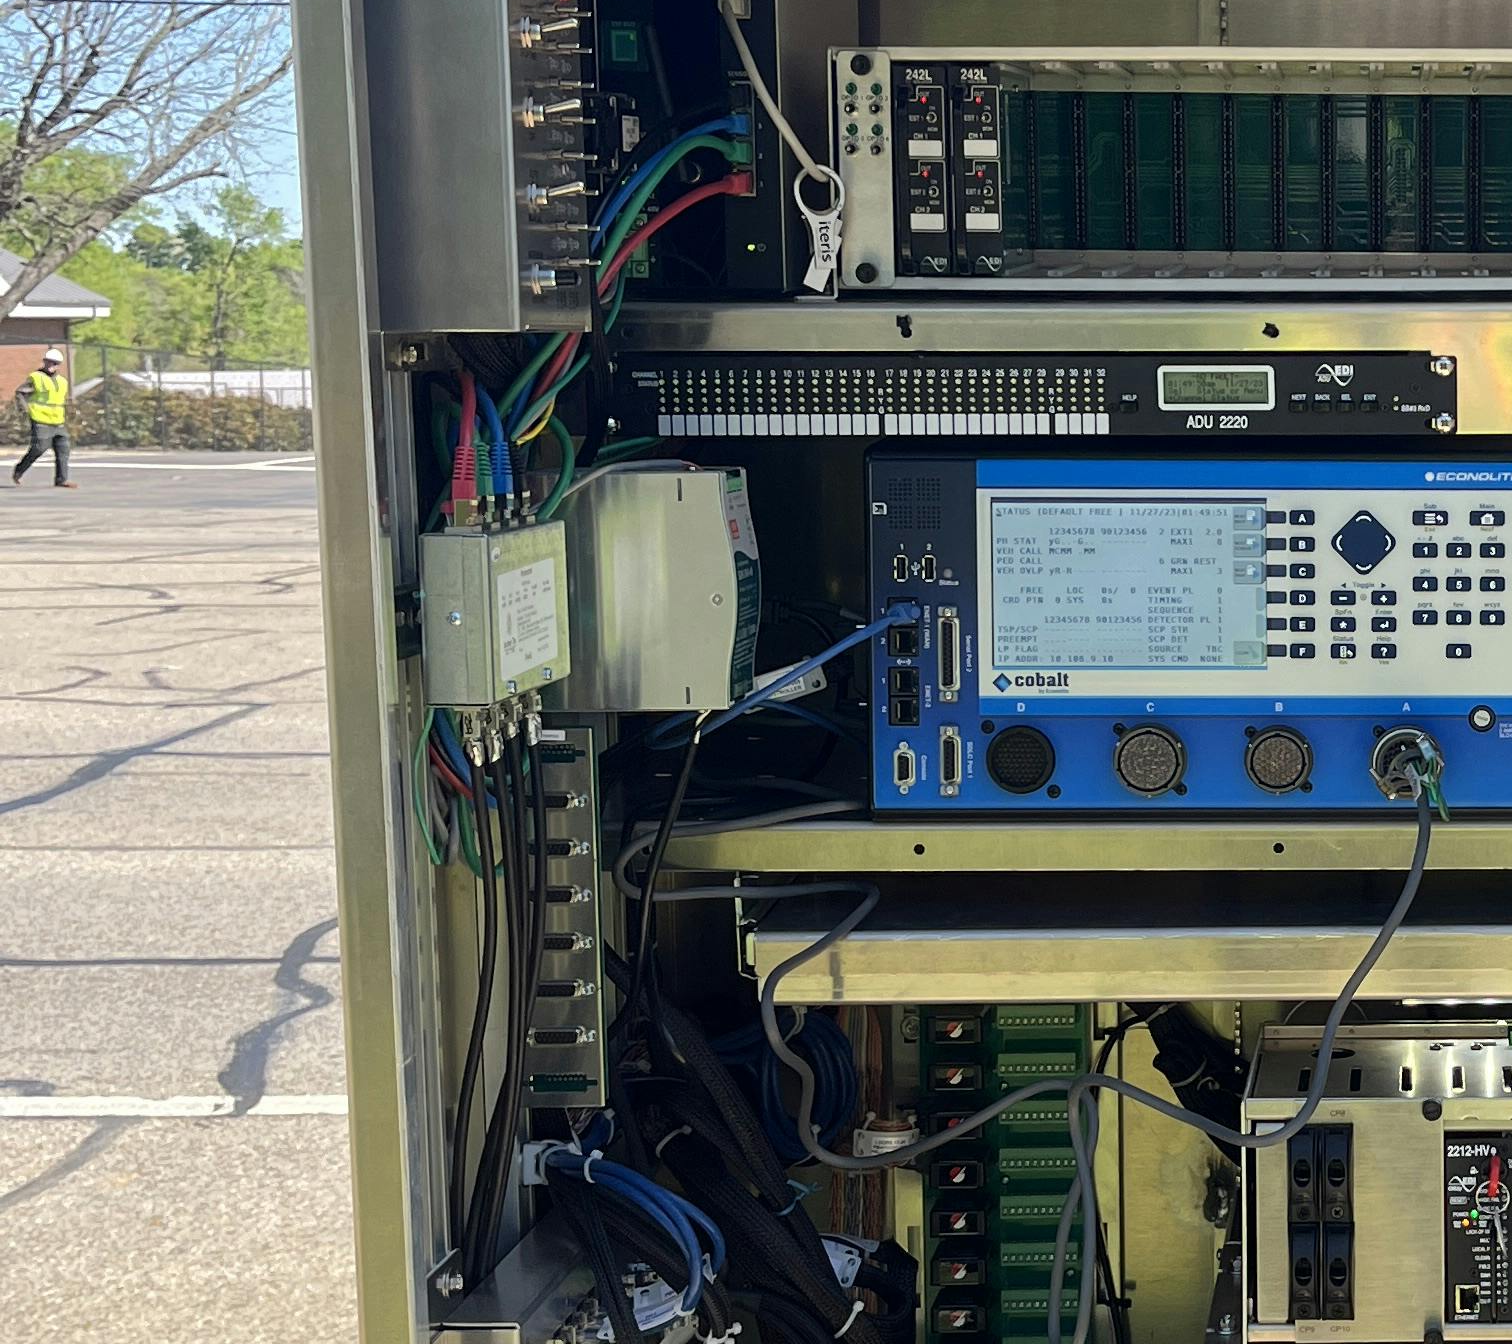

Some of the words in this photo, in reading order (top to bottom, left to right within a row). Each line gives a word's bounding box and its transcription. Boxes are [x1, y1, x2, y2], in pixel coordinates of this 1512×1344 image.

[905, 68, 932, 81] 242L
[960, 68, 988, 81] 242L
[818, 220, 832, 263] iteris
[783, 369, 793, 378] 10
[797, 369, 805, 378] 11
[810, 369, 820, 378] 12
[824, 369, 834, 378] 13
[838, 369, 848, 378] 14
[852, 369, 862, 378] 15
[866, 369, 875, 378] 16
[1334, 364, 1354, 376] EDI
[1186, 415, 1214, 428] ADU
[1219, 415, 1248, 428] 2220
[996, 507, 1031, 517] STATUS
[1089, 507, 1113, 516] FREE
[1298, 514, 1306, 523] A
[1049, 527, 1095, 536] 12345678
[1101, 527, 1148, 536] 90123456
[1014, 537, 1037, 545] STAT
[1298, 541, 1306, 549] B
[1020, 547, 1043, 555] CALL
[1456, 546, 1463, 555] 2
[1489, 546, 1496, 555] 3
[1020, 557, 1043, 565] CALL
[1298, 567, 1306, 577] C
[1422, 580, 1429, 589] 4
[1456, 580, 1462, 589] 5
[1489, 580, 1496, 589] 6
[1147, 586, 1177, 594] EVENT
[1147, 596, 1182, 604] TIMING
[1298, 594, 1306, 603] D
[1147, 606, 1194, 614] SEQUENCE
[1044, 616, 1090, 624] 12345678
[1096, 616, 1143, 624] 90123456
[1147, 616, 1194, 624] DETECTOR
[1422, 613, 1429, 623] 7
[1455, 613, 1462, 623] 8
[1489, 613, 1496, 623] 9
[1298, 621, 1306, 630] E
[1147, 645, 1182, 653] SOURCE
[1299, 648, 1306, 656] F
[1014, 672, 1069, 687] cobalt
[1017, 702, 1026, 712] D
[1146, 702, 1155, 712] C
[1275, 702, 1283, 712] B
[1402, 702, 1411, 712] A
[1447, 1145, 1490, 1157] 2212-HV
[1330, 1325, 1350, 1333] CP10
